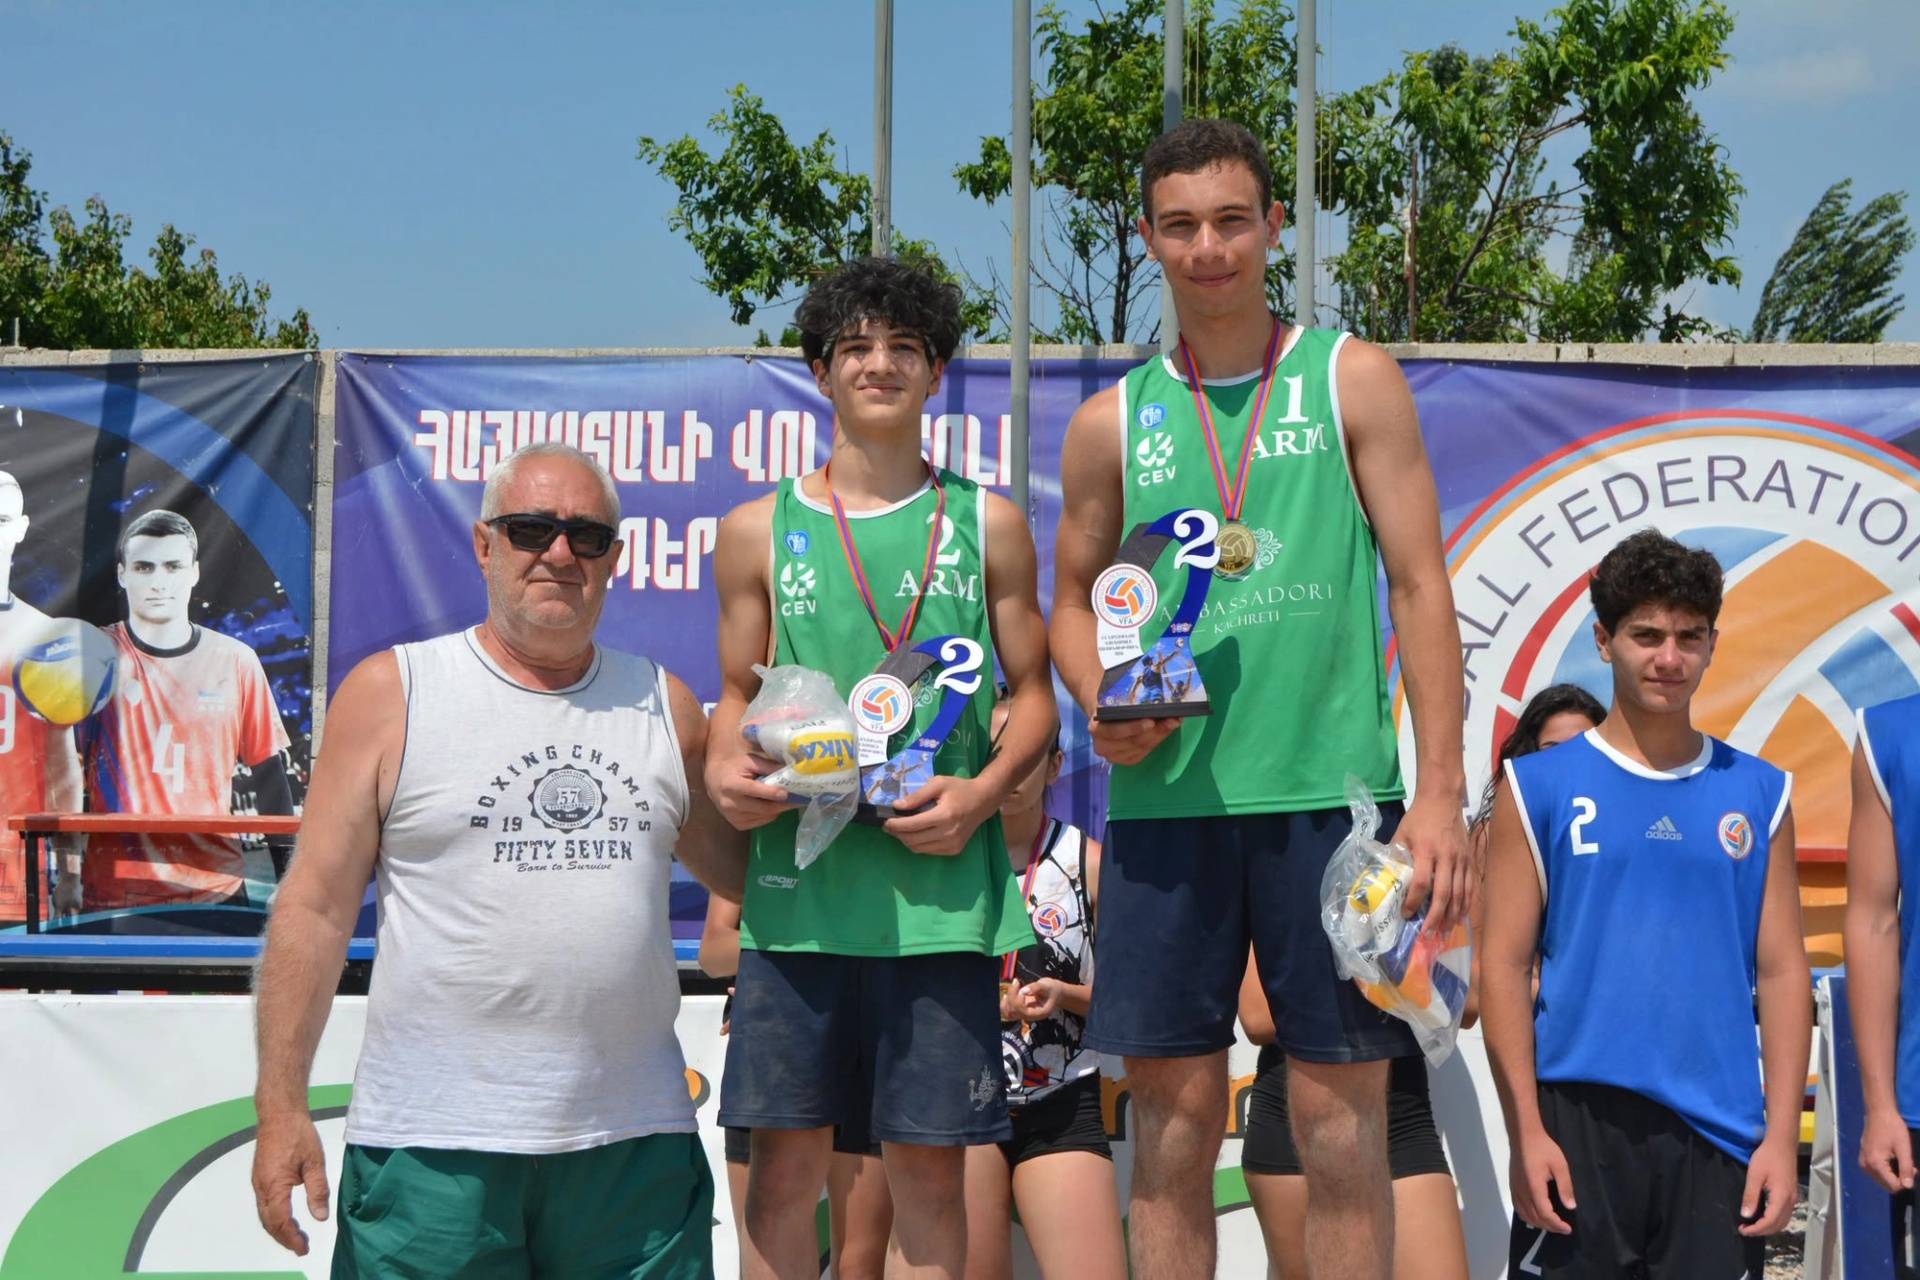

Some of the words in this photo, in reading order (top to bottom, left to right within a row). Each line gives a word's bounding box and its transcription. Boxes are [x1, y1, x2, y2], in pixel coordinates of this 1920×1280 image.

[1277, 373, 1309, 424] 1
[1250, 422, 1328, 461] ARM
[1137, 465, 1177, 487] CEV
[1518, 455, 1920, 569] FEDERATIO
[926, 511, 961, 565] 2
[1173, 509, 1221, 570] 2
[894, 568, 978, 602] ARM
[1159, 583, 1332, 622] ABASSADORI
[781, 599, 817, 617] CEV
[1118, 617, 1133, 625] VFA
[934, 637, 984, 695] 2
[152, 722, 186, 794] 4
[470, 745, 558, 829] BOXING
[571, 744, 651, 832] CHAMPS
[560, 791, 578, 805] 57
[502, 816, 523, 833] 19
[608, 816, 629, 832] 57
[1570, 796, 1599, 856] 2
[1645, 829, 1683, 841] adidas
[493, 839, 557, 863] FIFTY
[565, 839, 633, 861] SEVEN
[517, 862, 547, 873] Born
[552, 862, 563, 871] to
[566, 860, 613, 871] Survive
